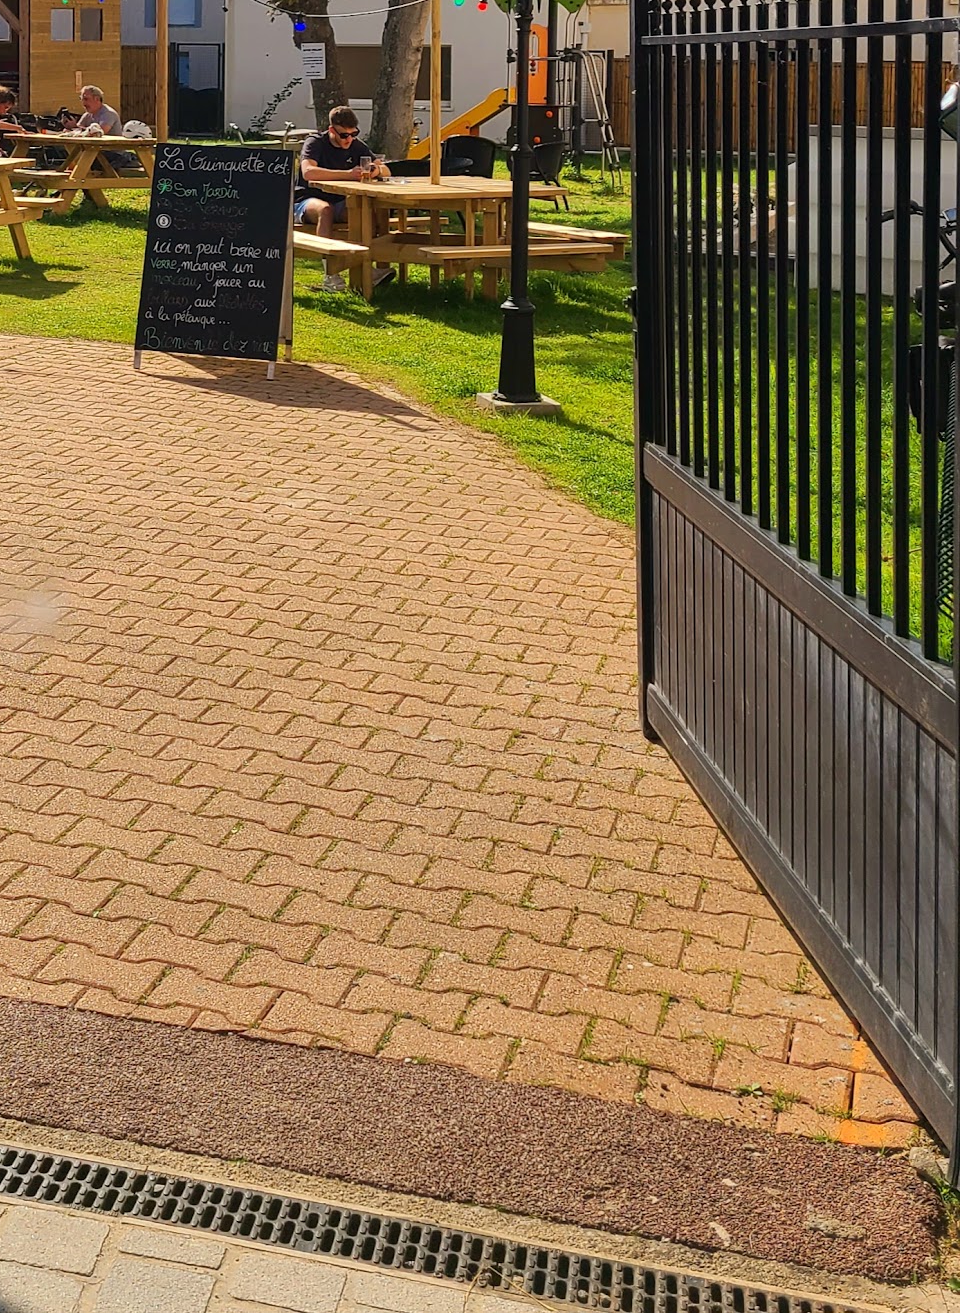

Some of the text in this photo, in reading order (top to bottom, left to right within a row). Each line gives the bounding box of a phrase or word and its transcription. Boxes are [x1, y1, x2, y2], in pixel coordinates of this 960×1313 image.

[159, 147, 185, 171] La
[189, 150, 266, 184] Guinguette
[173, 182, 198, 197] Son
[153, 237, 281, 261] ici on peut boire un
[181, 260, 228, 281] manger
[232, 262, 254, 274] un
[213, 275, 242, 298] jouer
[248, 279, 266, 289] au
[194, 296, 217, 308] aux
[144, 307, 154, 319] à
[157, 305, 171, 321] la
